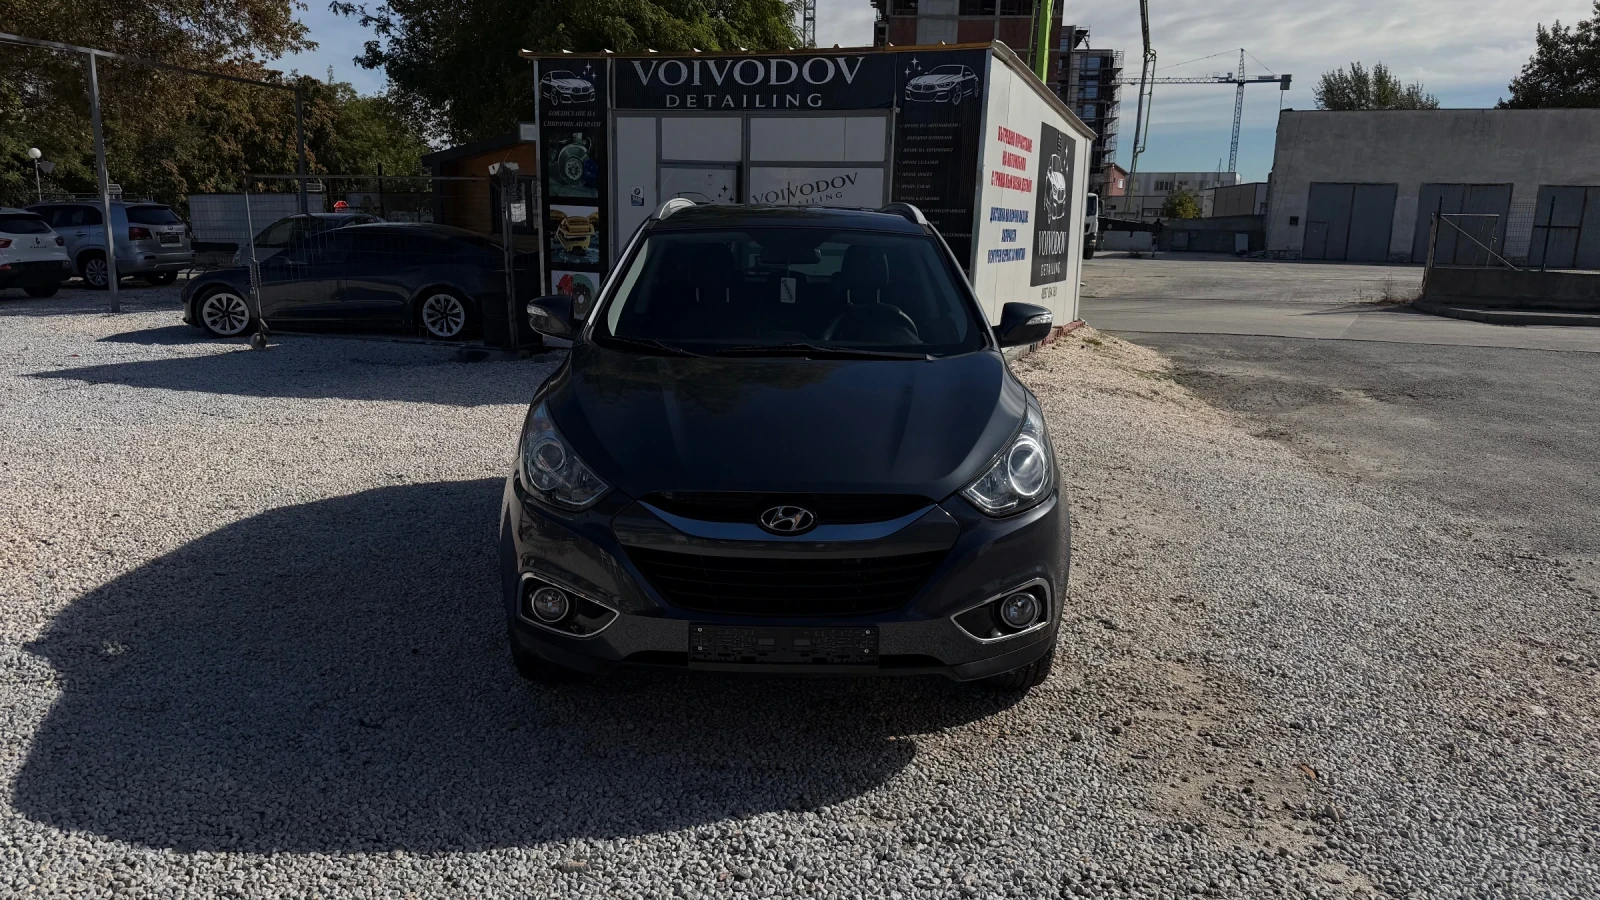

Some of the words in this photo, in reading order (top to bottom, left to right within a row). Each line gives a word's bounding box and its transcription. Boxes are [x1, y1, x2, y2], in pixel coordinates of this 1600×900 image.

[631, 56, 866, 86] VOIVODOV
[665, 93, 822, 108] DETAILING
[752, 172, 858, 205] VOIVODOV
[1038, 230, 1067, 256] VOIVODOV
